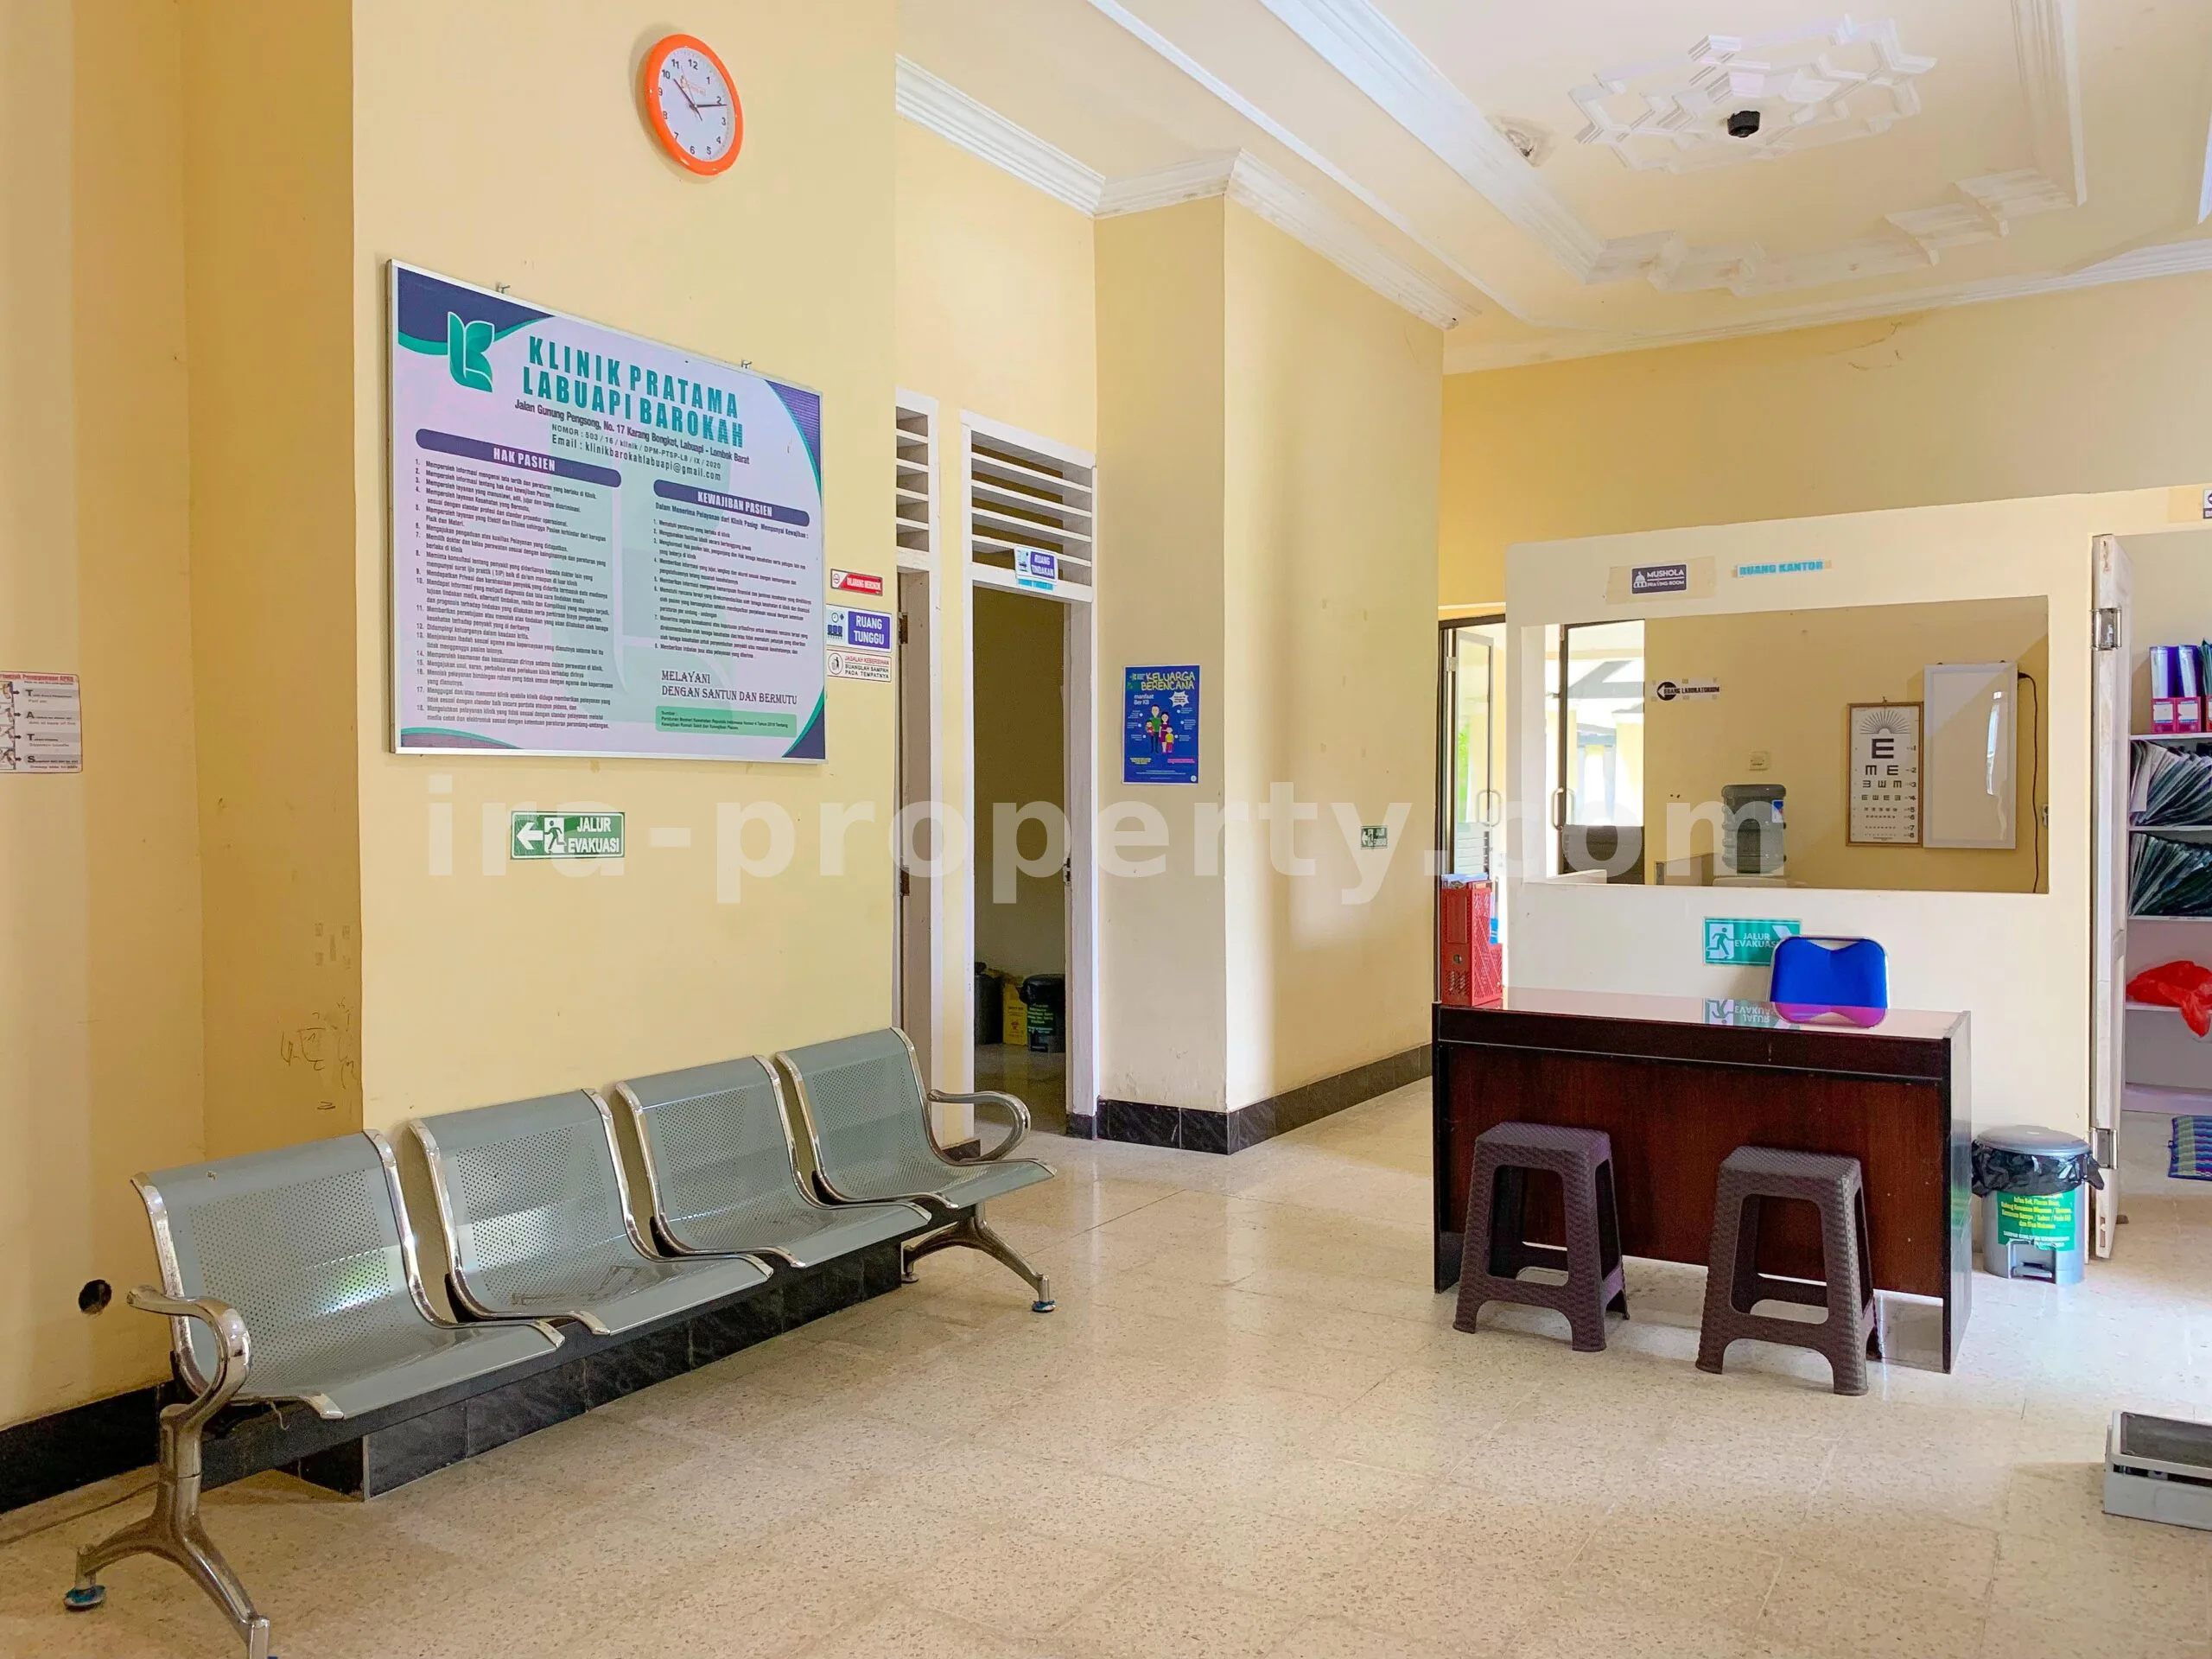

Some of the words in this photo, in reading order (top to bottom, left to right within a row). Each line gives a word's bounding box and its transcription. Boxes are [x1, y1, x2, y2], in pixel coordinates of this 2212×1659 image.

[671, 59, 679, 69] 11
[688, 59, 698, 70] 12
[662, 69, 671, 79] 10
[690, 146, 695, 155] 6
[707, 146, 712, 155] 5
[529, 335, 620, 387] KLINIK
[629, 365, 737, 418] PRATAMA
[523, 365, 631, 420] LABUAPI
[639, 397, 742, 448] BAROKAH
[514, 398, 535, 413] Jalan
[537, 404, 564, 422] Gunung
[566, 411, 601, 430] Pengsong,
[603, 420, 614, 432] No.
[616, 423, 625, 434] 17
[626, 426, 650, 442] Karang
[680, 439, 703, 454] Labuapi
[709, 447, 733, 461] Lombok
[734, 452, 750, 464] Barat
[493, 448, 515, 463] HAK
[518, 453, 555, 472] PASIEN
[552, 434, 576, 448] Email
[585, 442, 721, 480] klinikbarokahlabuapi@gmail.com
[697, 491, 743, 511] KEWAJIBAN
[745, 501, 772, 517] PASIEN
[1779, 561, 1823, 572] KANTOR
[855, 615, 882, 630] RUANG
[854, 631, 885, 645] TUNGGU
[661, 670, 710, 684] MELAYANI
[1146, 671, 1195, 682] KELUARGA
[1141, 680, 1195, 691] BERENCANA
[662, 685, 700, 697] DENGAN
[702, 688, 736, 701] SANTUN
[739, 691, 757, 702] DAN
[759, 692, 797, 705] BERMUTU
[576, 817, 611, 832] JALUR
[568, 837, 620, 853] EVAKUASI
